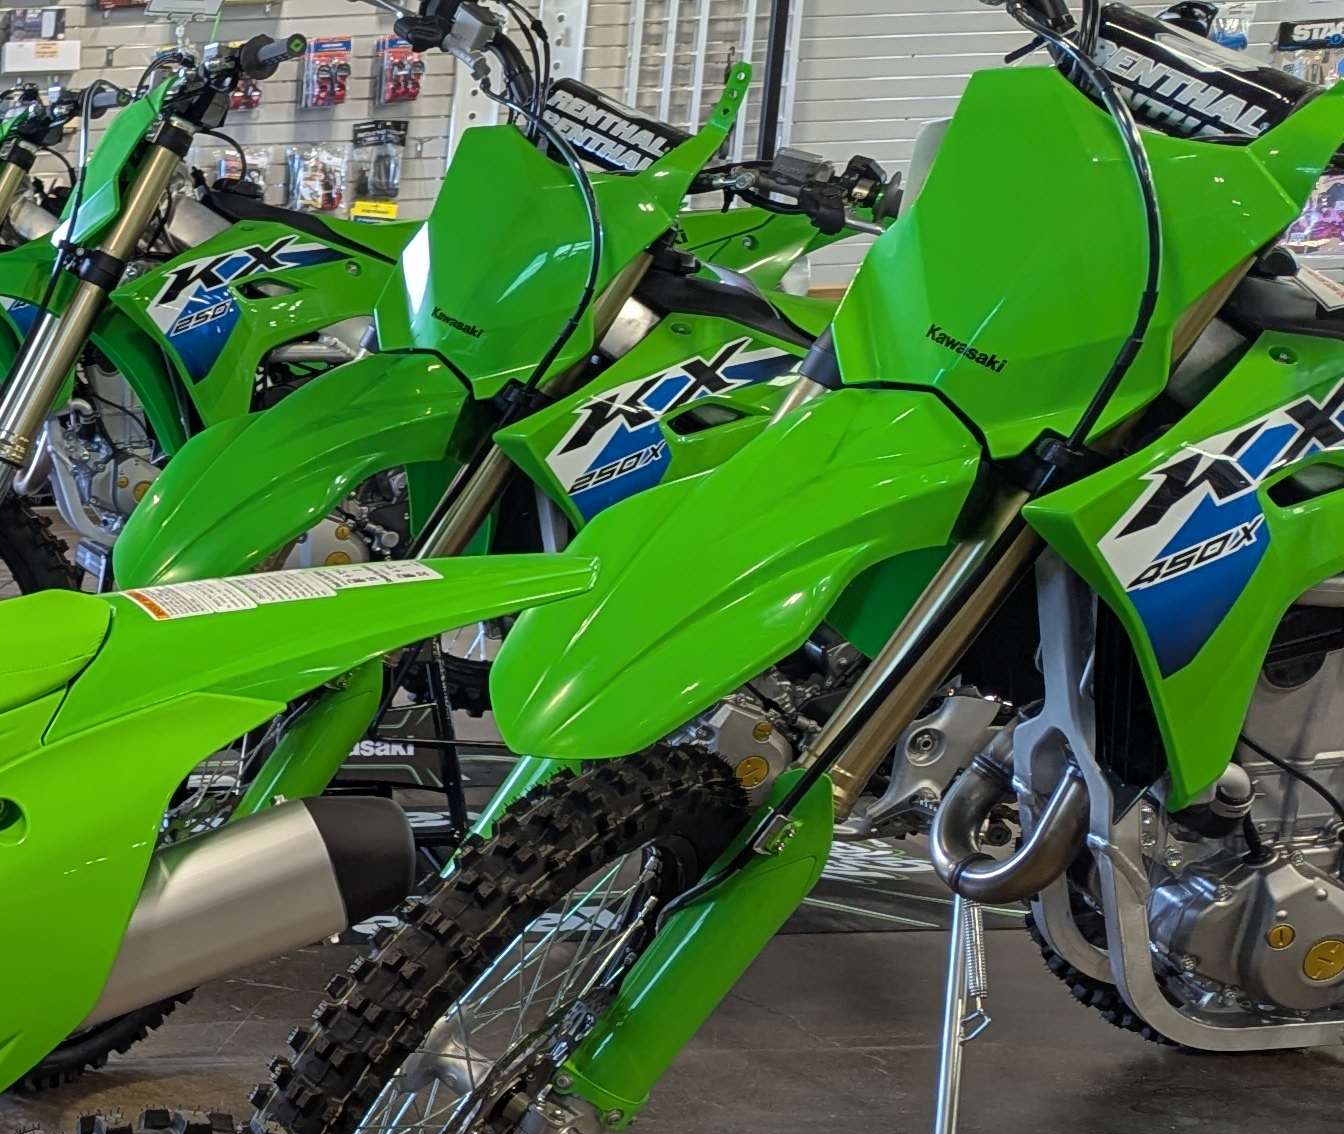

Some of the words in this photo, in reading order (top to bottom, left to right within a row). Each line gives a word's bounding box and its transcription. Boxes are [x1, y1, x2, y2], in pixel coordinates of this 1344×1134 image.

[546, 89, 669, 158] RENTHAL
[155, 234, 300, 308] KX
[173, 300, 232, 334] 250
[429, 305, 485, 341] Kawasaki
[924, 323, 1009, 374] Kawasaki
[557, 336, 752, 456] KX
[568, 439, 666, 496] 250X
[1113, 380, 1344, 541] KX
[1125, 513, 1266, 590] 450X
